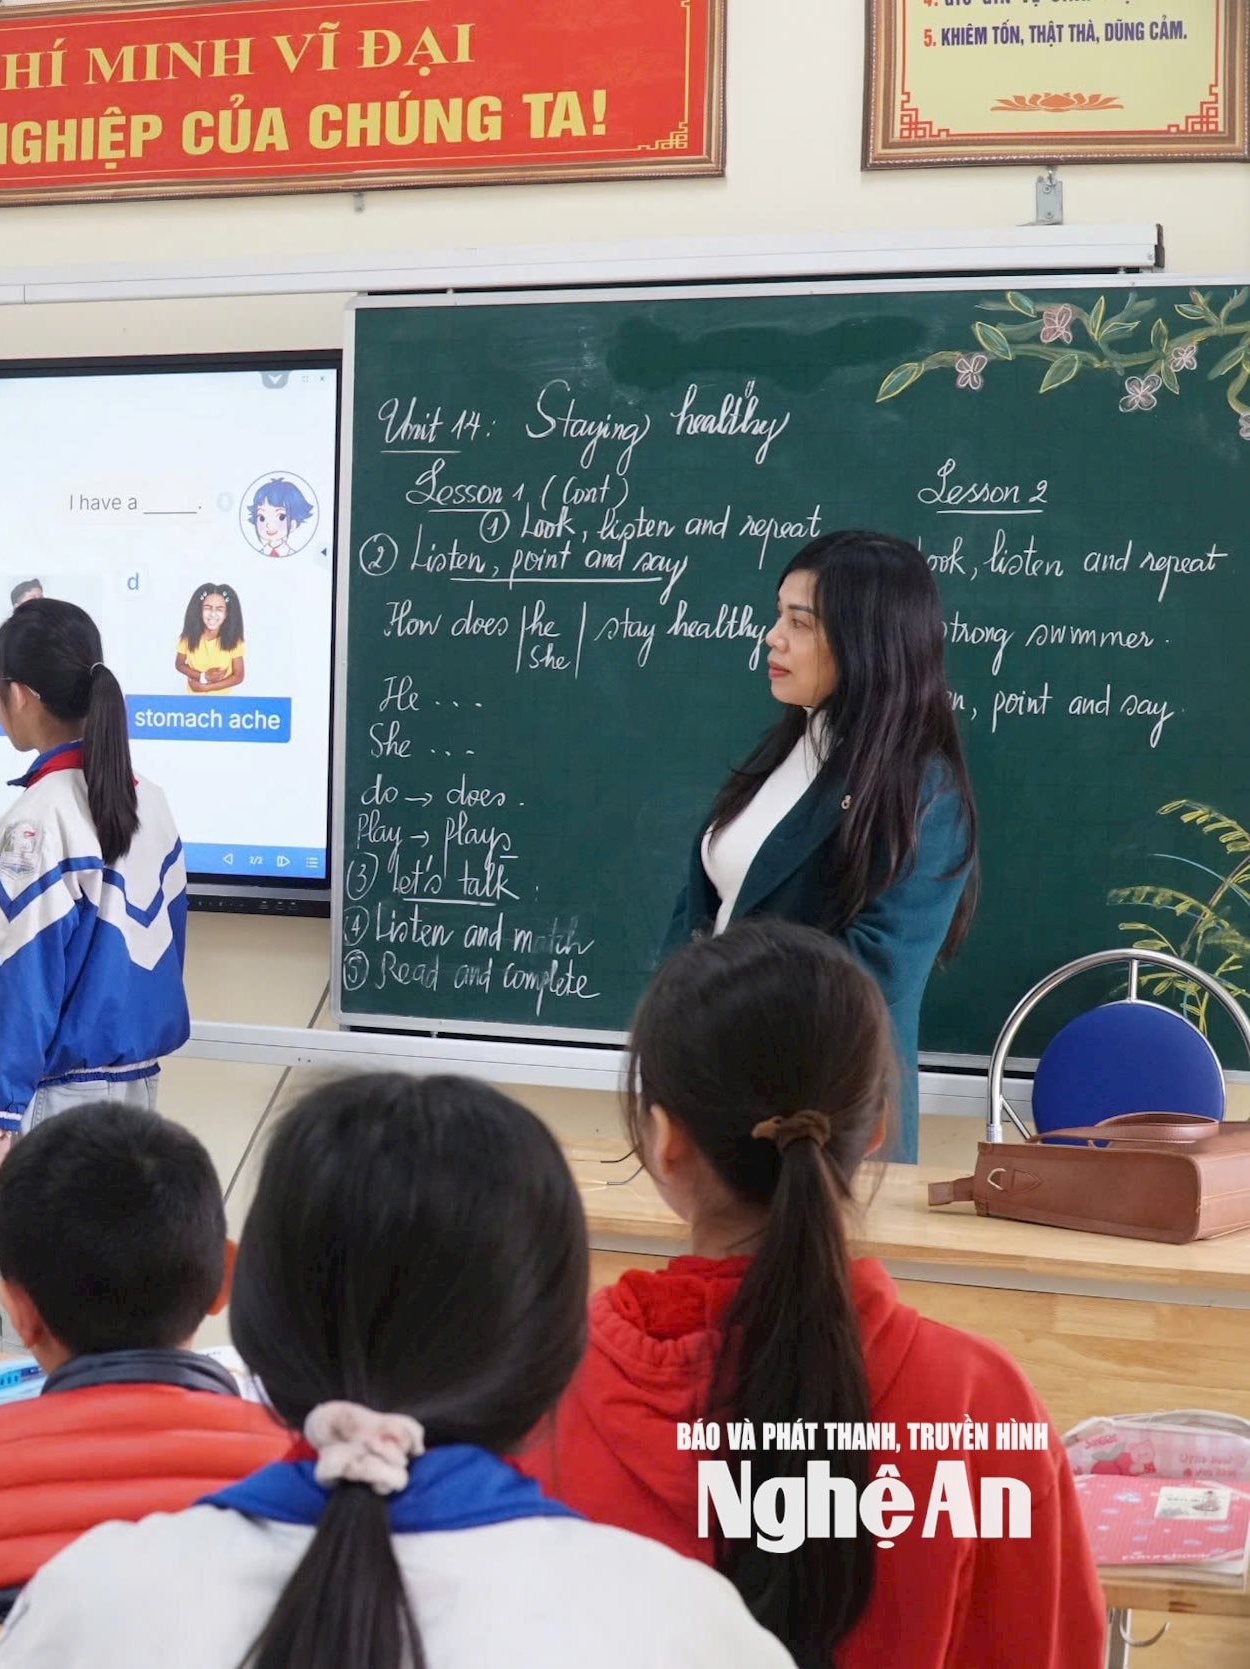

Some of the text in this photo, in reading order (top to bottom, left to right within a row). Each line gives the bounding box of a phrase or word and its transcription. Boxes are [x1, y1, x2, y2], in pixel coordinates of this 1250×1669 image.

[84, 36, 254, 86] MINH
[273, 22, 340, 74] VĨ
[358, 23, 476, 77] ĐẠI
[924, 14, 1187, 47] 5. KHIÊM TỐN, THẬT THÀ, DŨNG CẢM.
[181, 94, 290, 156] CỦA
[308, 90, 502, 149] CHÚNG
[522, 89, 608, 138] TA!
[379, 397, 443, 444] Unit
[525, 379, 790, 476] Staying healthy
[79, 494, 122, 511] have
[128, 497, 138, 511] a
[405, 457, 503, 505] Lesson
[918, 458, 1048, 505] Lesson 2
[597, 506, 676, 541] listen
[685, 505, 730, 538] and
[739, 504, 823, 569] repeat
[127, 573, 139, 591] d
[510, 537, 572, 590] point
[585, 540, 627, 571] and
[632, 550, 688, 604] say
[984, 529, 1063, 577] listen
[1083, 540, 1131, 572] and
[1140, 543, 1228, 602] repeat
[383, 600, 766, 671] How does he stay healthy
[378, 675, 420, 713] He
[992, 682, 1053, 732] point
[1069, 684, 1111, 716] and
[134, 709, 281, 731] stomach ache
[370, 721, 412, 759] She
[361, 773, 398, 806] do
[249, 856, 263, 865] 2/2
[375, 902, 454, 947] Listen
[464, 912, 503, 951] and
[375, 951, 600, 1016] Read and complete
